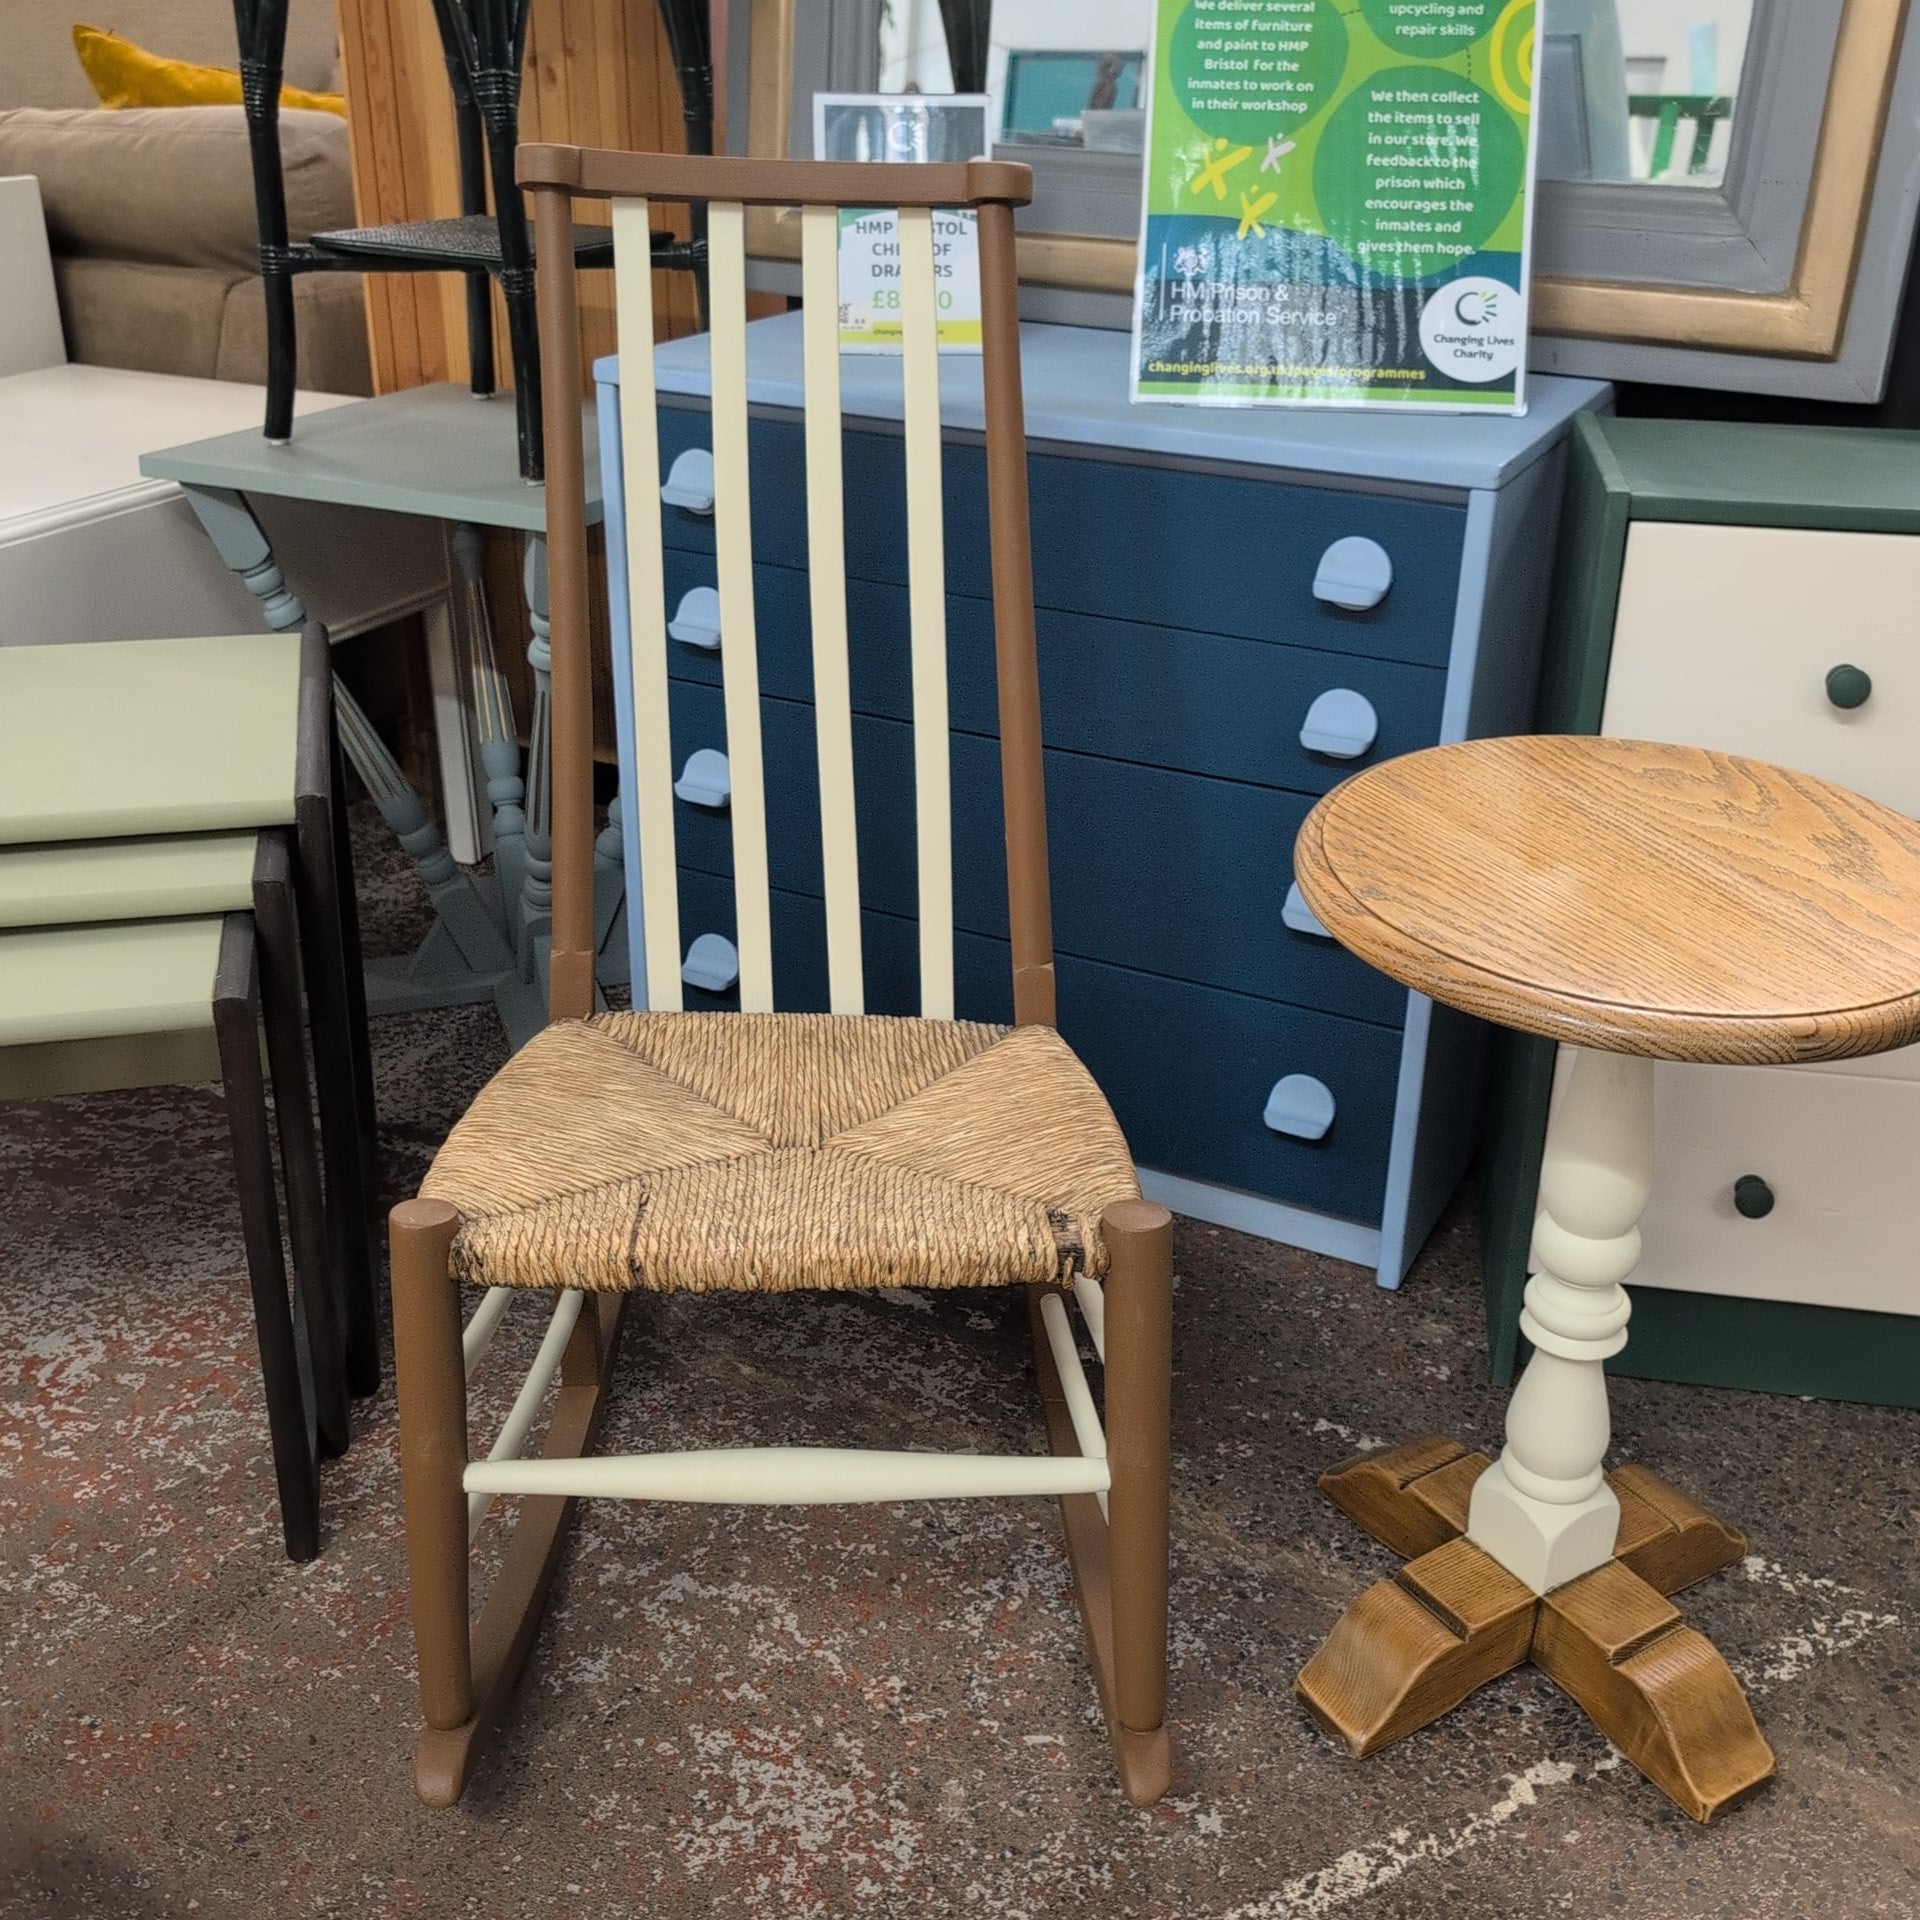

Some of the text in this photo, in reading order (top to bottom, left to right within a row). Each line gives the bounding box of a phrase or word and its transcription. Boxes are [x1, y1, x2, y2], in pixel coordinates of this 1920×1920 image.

[1194, 0, 1315, 13] We deliver several
[1388, 3, 1485, 18] upcycling and
[1194, 18, 1314, 33] items of furniture
[1395, 22, 1476, 38] repair skills
[1196, 39, 1309, 53] and paint to HMP
[1203, 58, 1300, 73] Bristol for the
[1187, 77, 1314, 93] inmates to work on
[1371, 90, 1481, 104] We then collect
[1191, 97, 1308, 115] in their workshop
[1367, 111, 1481, 126] the items to sell
[1367, 132, 1383, 146] in
[1383, 134, 1411, 146] our
[1455, 135, 1479, 148] We
[1366, 153, 1479, 170] feedback to the
[1375, 175, 1467, 191] prison which
[1364, 199, 1475, 214] encourages the
[856, 221, 893, 234] HMP
[1375, 217, 1462, 234] inmates and
[1357, 240, 1477, 257] gives them hope.
[872, 264, 953, 278] DRRS
[1171, 281, 1289, 302] HM Prison &
[1169, 304, 1337, 326] Probation Service
[1433, 333, 1515, 347] Changing Lives
[1453, 348, 1495, 361] Charity
